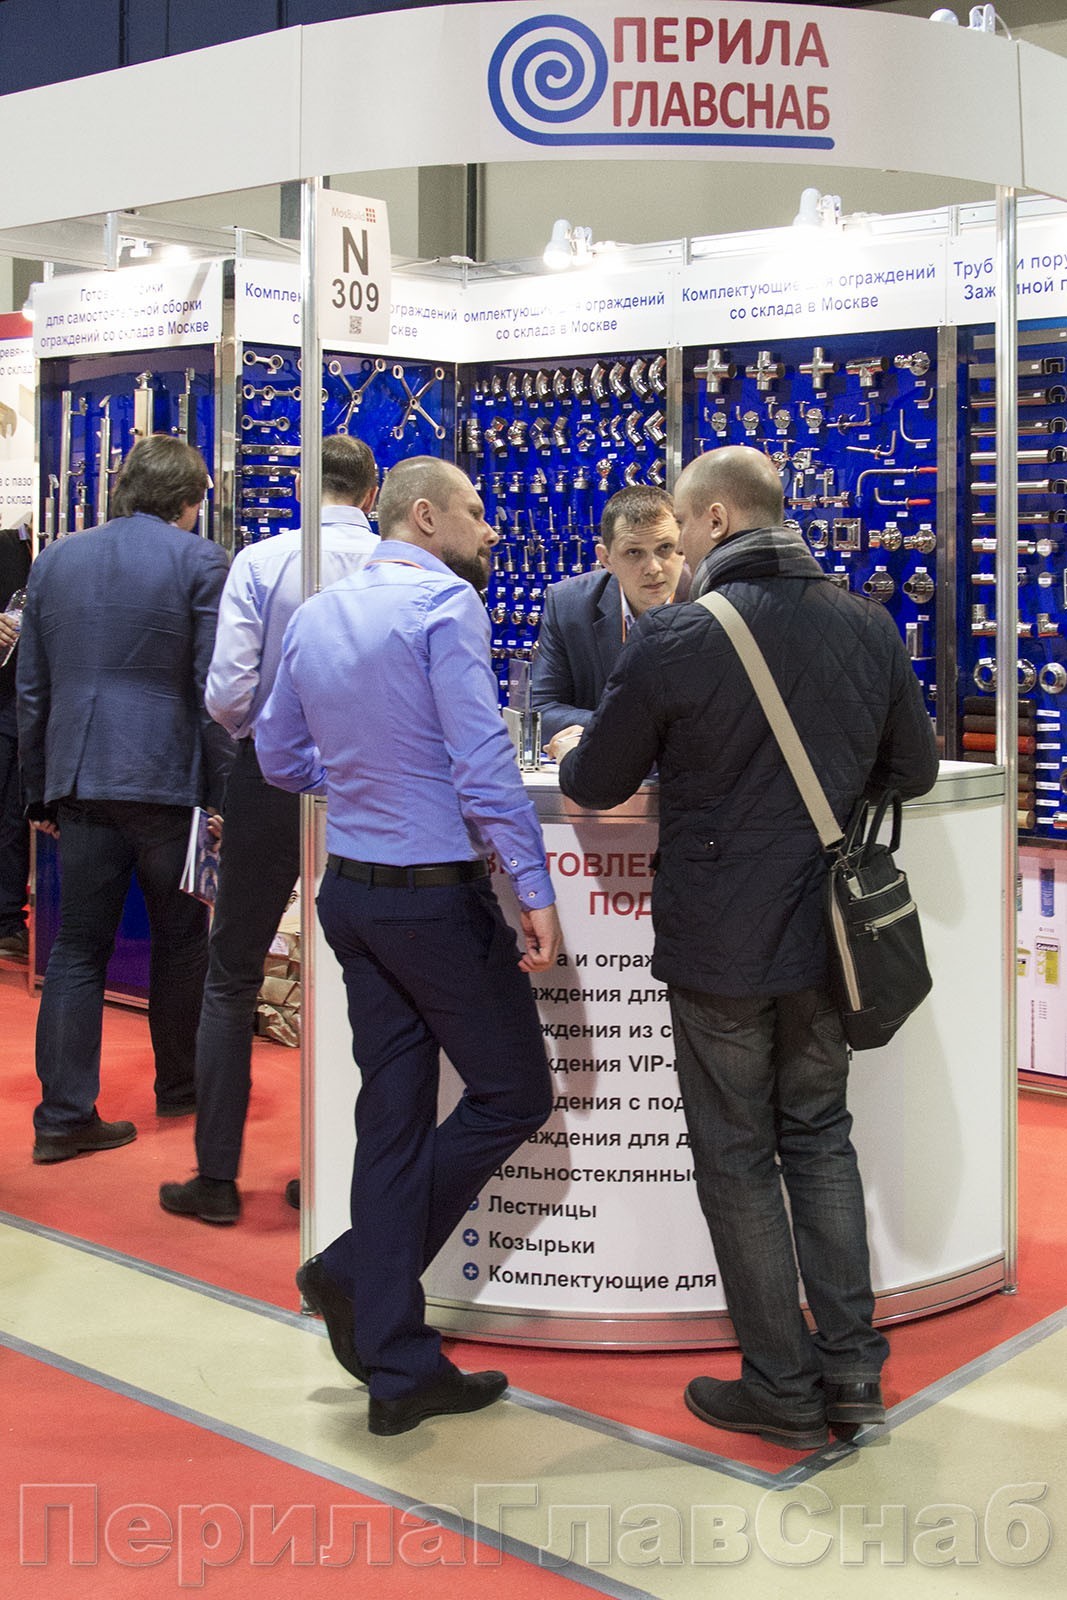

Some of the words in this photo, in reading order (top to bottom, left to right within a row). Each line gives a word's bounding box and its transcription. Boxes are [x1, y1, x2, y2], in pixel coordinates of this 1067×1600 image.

[613, 17, 830, 68] ПЕРИЛА
[613, 81, 830, 130] ГЛАВСНАБ
[342, 226, 369, 276] N
[953, 258, 993, 280] Труб
[1031, 254, 1067, 271] пор
[332, 278, 380, 313] 309
[681, 280, 800, 302] Комплектующие
[839, 264, 936, 287] ограждений
[46, 314, 65, 328] для
[163, 298, 202, 314] сборки
[464, 306, 553, 322] омплектующи
[586, 291, 665, 312] ограждений
[730, 307, 746, 320] со
[751, 303, 802, 318] склада
[808, 301, 816, 313] в
[821, 295, 879, 312] Москве
[40, 329, 100, 349] ограждений
[103, 330, 115, 342] со
[158, 326, 165, 337] в
[168, 319, 209, 334] Москве
[391, 326, 418, 337] скве
[496, 329, 510, 340] со
[514, 325, 556, 339] склада
[560, 324, 567, 335] в
[572, 318, 618, 333] Москве
[576, 954, 588, 967] и
[628, 989, 669, 1005] для
[629, 1025, 653, 1038] из
[551, 1096, 621, 1112] дения
[629, 1097, 640, 1110] с
[628, 1132, 669, 1149] для
[488, 1195, 597, 1220] Лестницы
[488, 1231, 596, 1255] Козырьки
[488, 1265, 669, 1292] Комплектующие
[675, 1274, 717, 1291] для
